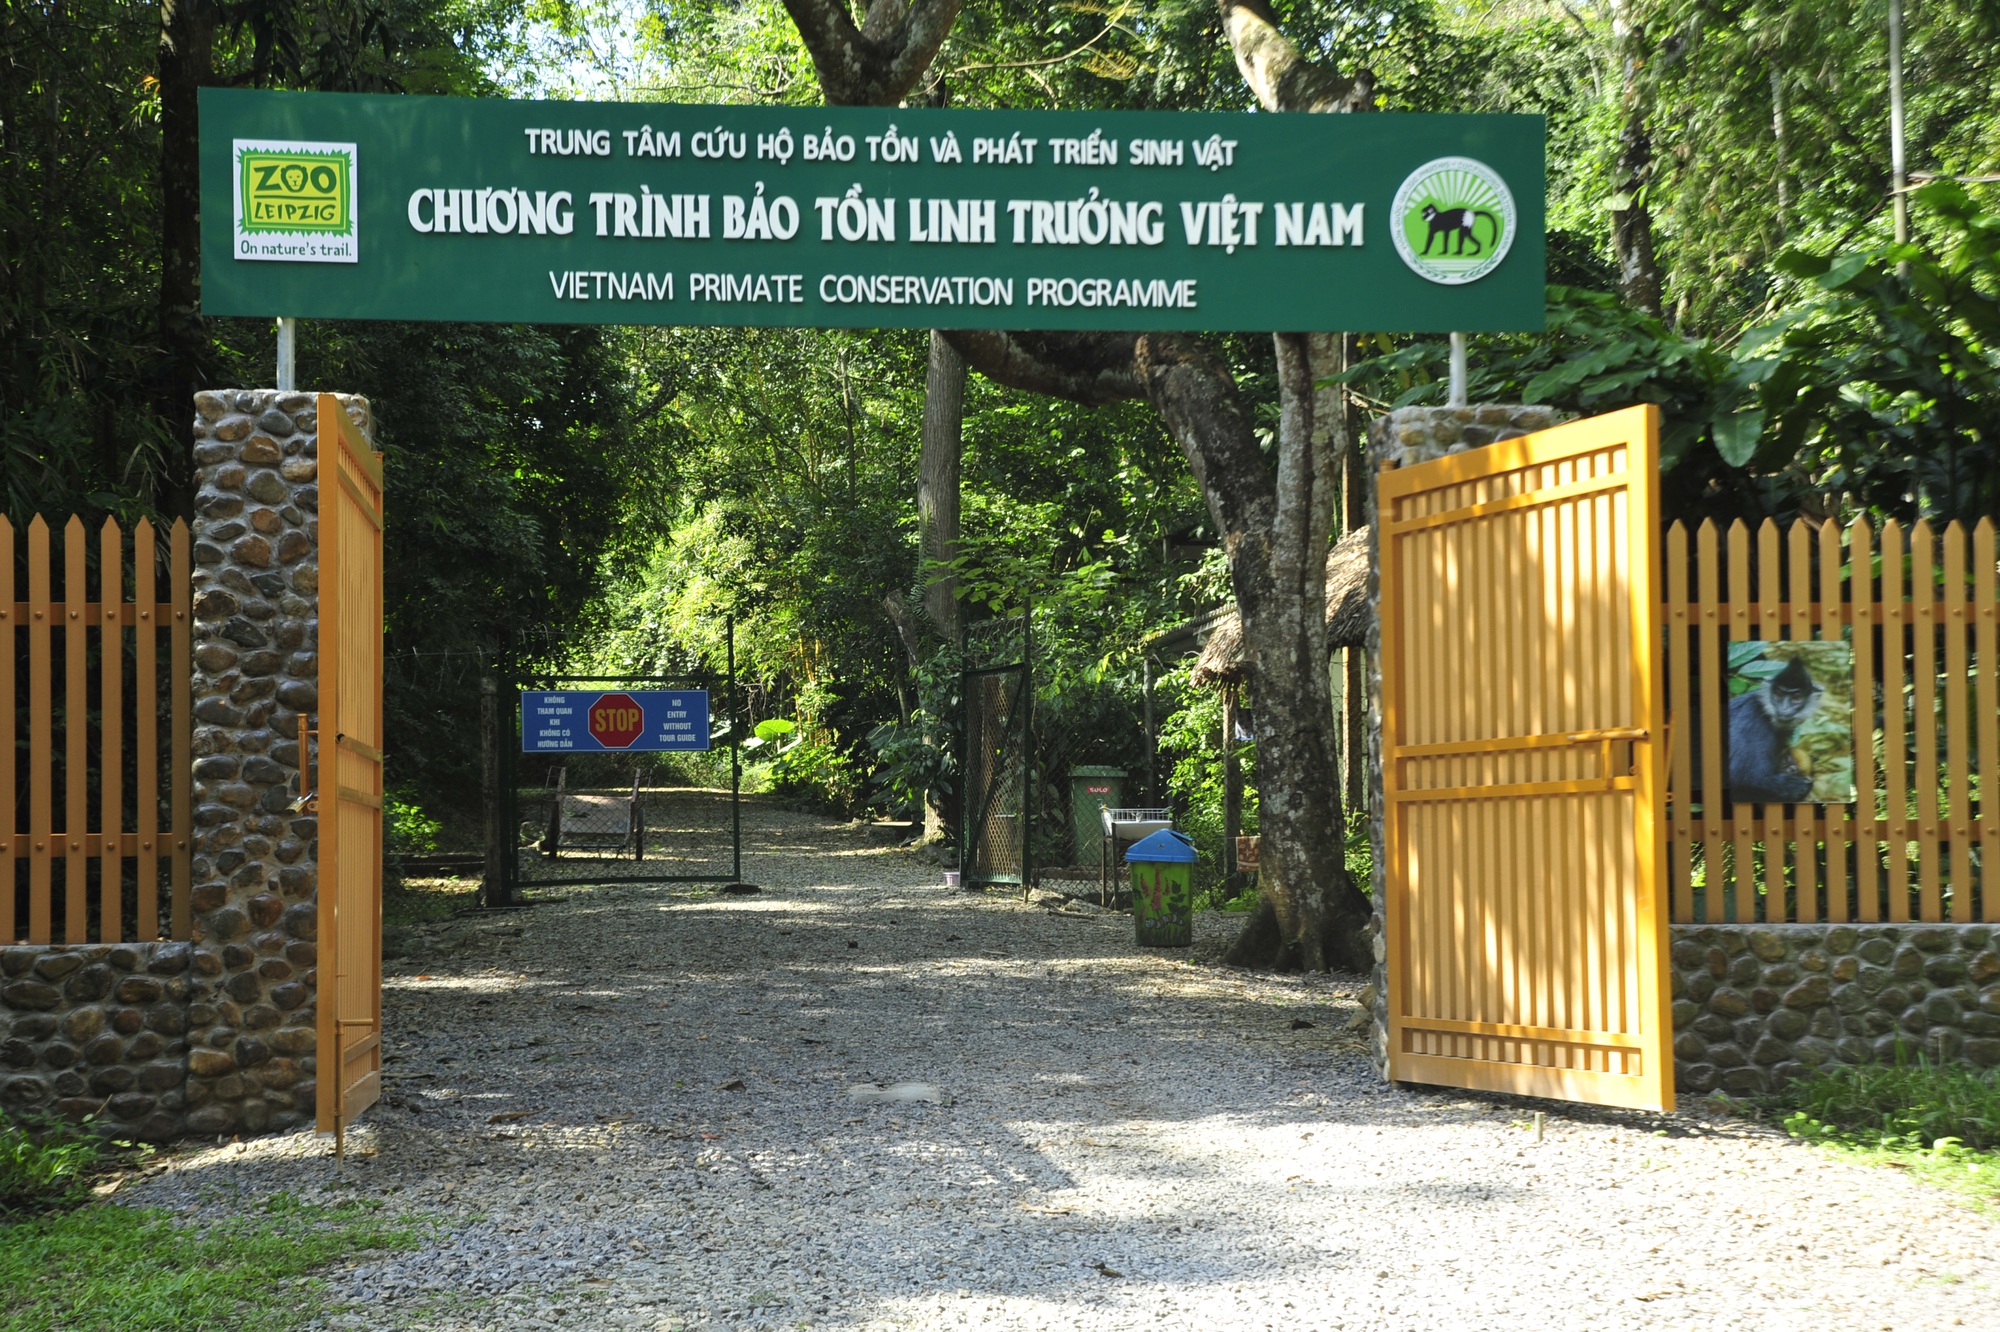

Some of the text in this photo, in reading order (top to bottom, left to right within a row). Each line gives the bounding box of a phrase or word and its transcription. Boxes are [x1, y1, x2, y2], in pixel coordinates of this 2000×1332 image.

[525, 124, 1237, 171] TRUNG TÂM CỨU HỘ BẢO TỒN VÀ PHÁT TRIỂN SINH VẬT
[253, 164, 337, 194] ZOO
[254, 201, 337, 221] LEIPZIG
[408, 187, 573, 234] CHƯƠNG
[589, 185, 710, 237] TRÌNH
[723, 181, 799, 239] BẢO
[815, 183, 895, 241] TỒN
[909, 199, 995, 242] LINH
[1007, 187, 1164, 245] TRƯỞNG
[1180, 194, 1263, 254] VIỆT
[1275, 203, 1364, 245] NAM
[240, 240, 352, 257] On nature's trail.
[549, 271, 1196, 307] VIETNAM PRIMATE CONSERVATION PROGRAMME
[543, 695, 565, 704] KHÔNG
[671, 699, 682, 707] NO
[537, 707, 573, 715] THAM QUAN
[667, 710, 687, 719] ENTRY
[549, 718, 561, 726] KHI
[595, 708, 640, 732] STOP
[662, 722, 692, 730] WITHOUT
[539, 728, 561, 737] KHÔNG
[659, 733, 696, 742] TOUR GUIDE
